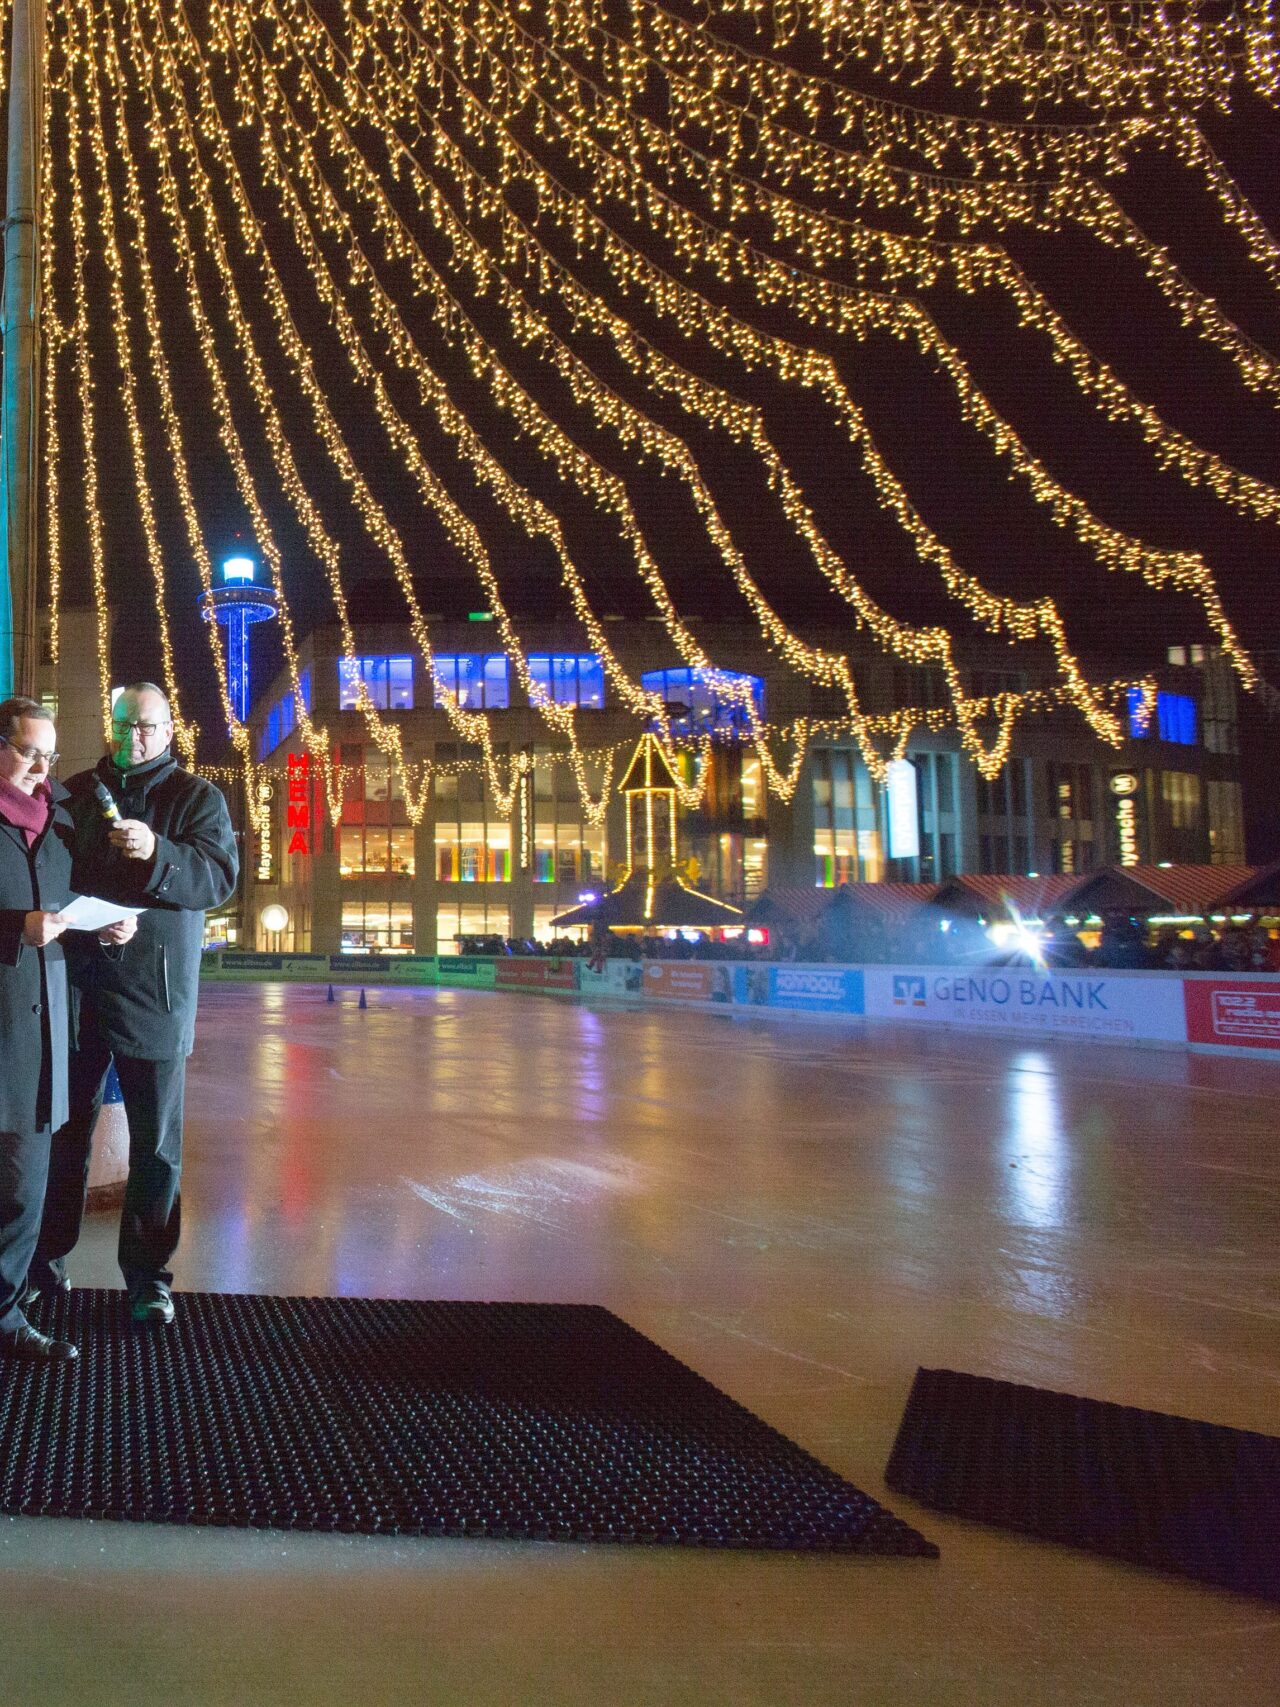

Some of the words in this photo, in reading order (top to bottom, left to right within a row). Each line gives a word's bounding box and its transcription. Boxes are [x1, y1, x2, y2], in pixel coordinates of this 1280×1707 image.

[258, 804, 273, 880] Mayersche
[287, 753, 310, 855] HEMA
[933, 976, 1011, 1004] GENO
[1020, 980, 1108, 1010] BANK
